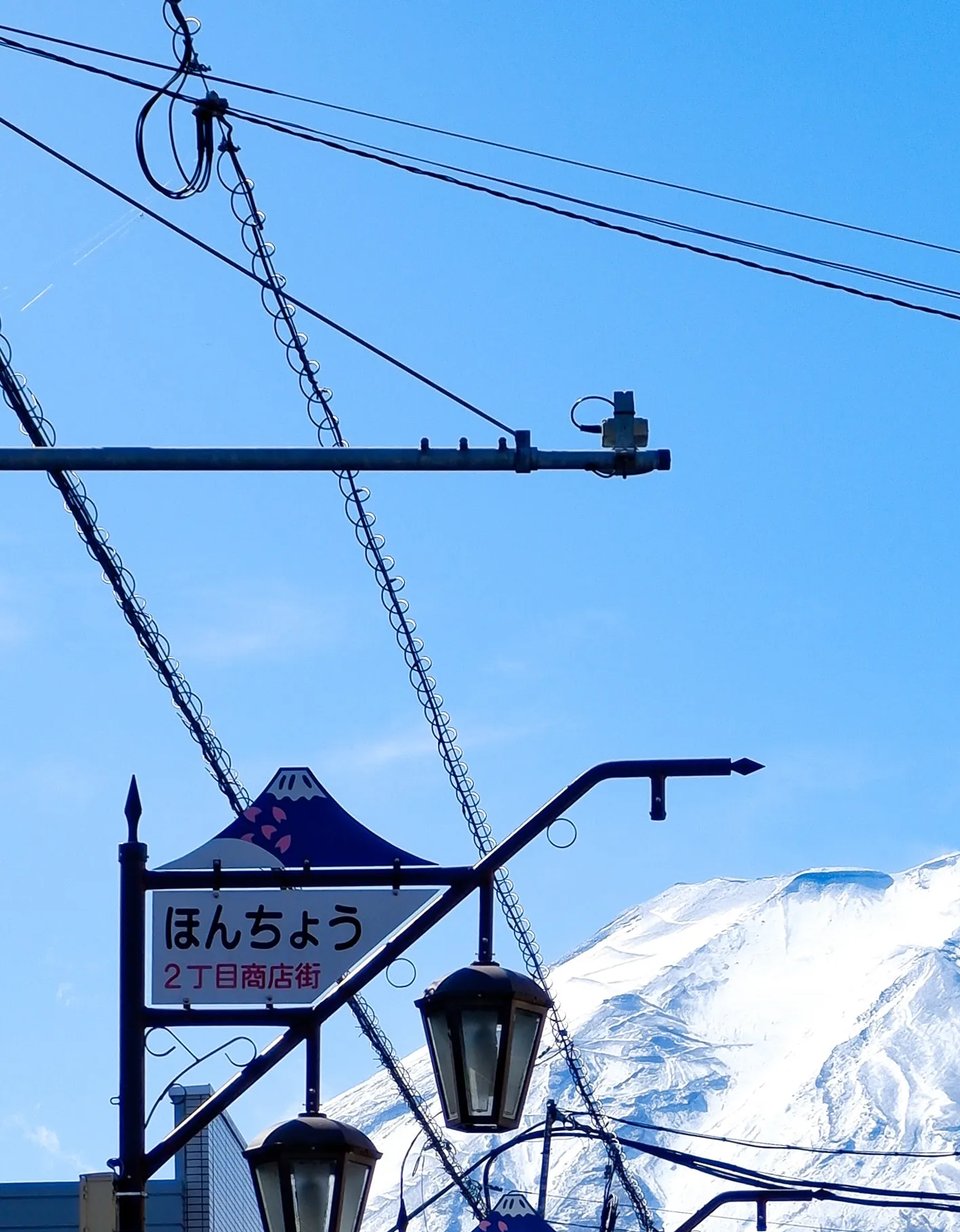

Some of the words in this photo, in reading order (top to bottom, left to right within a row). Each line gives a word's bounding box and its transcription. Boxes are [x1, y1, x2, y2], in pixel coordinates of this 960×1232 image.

[165, 904, 363, 951] ほんちょう
[164, 962, 321, 990] 2丁目商店街
